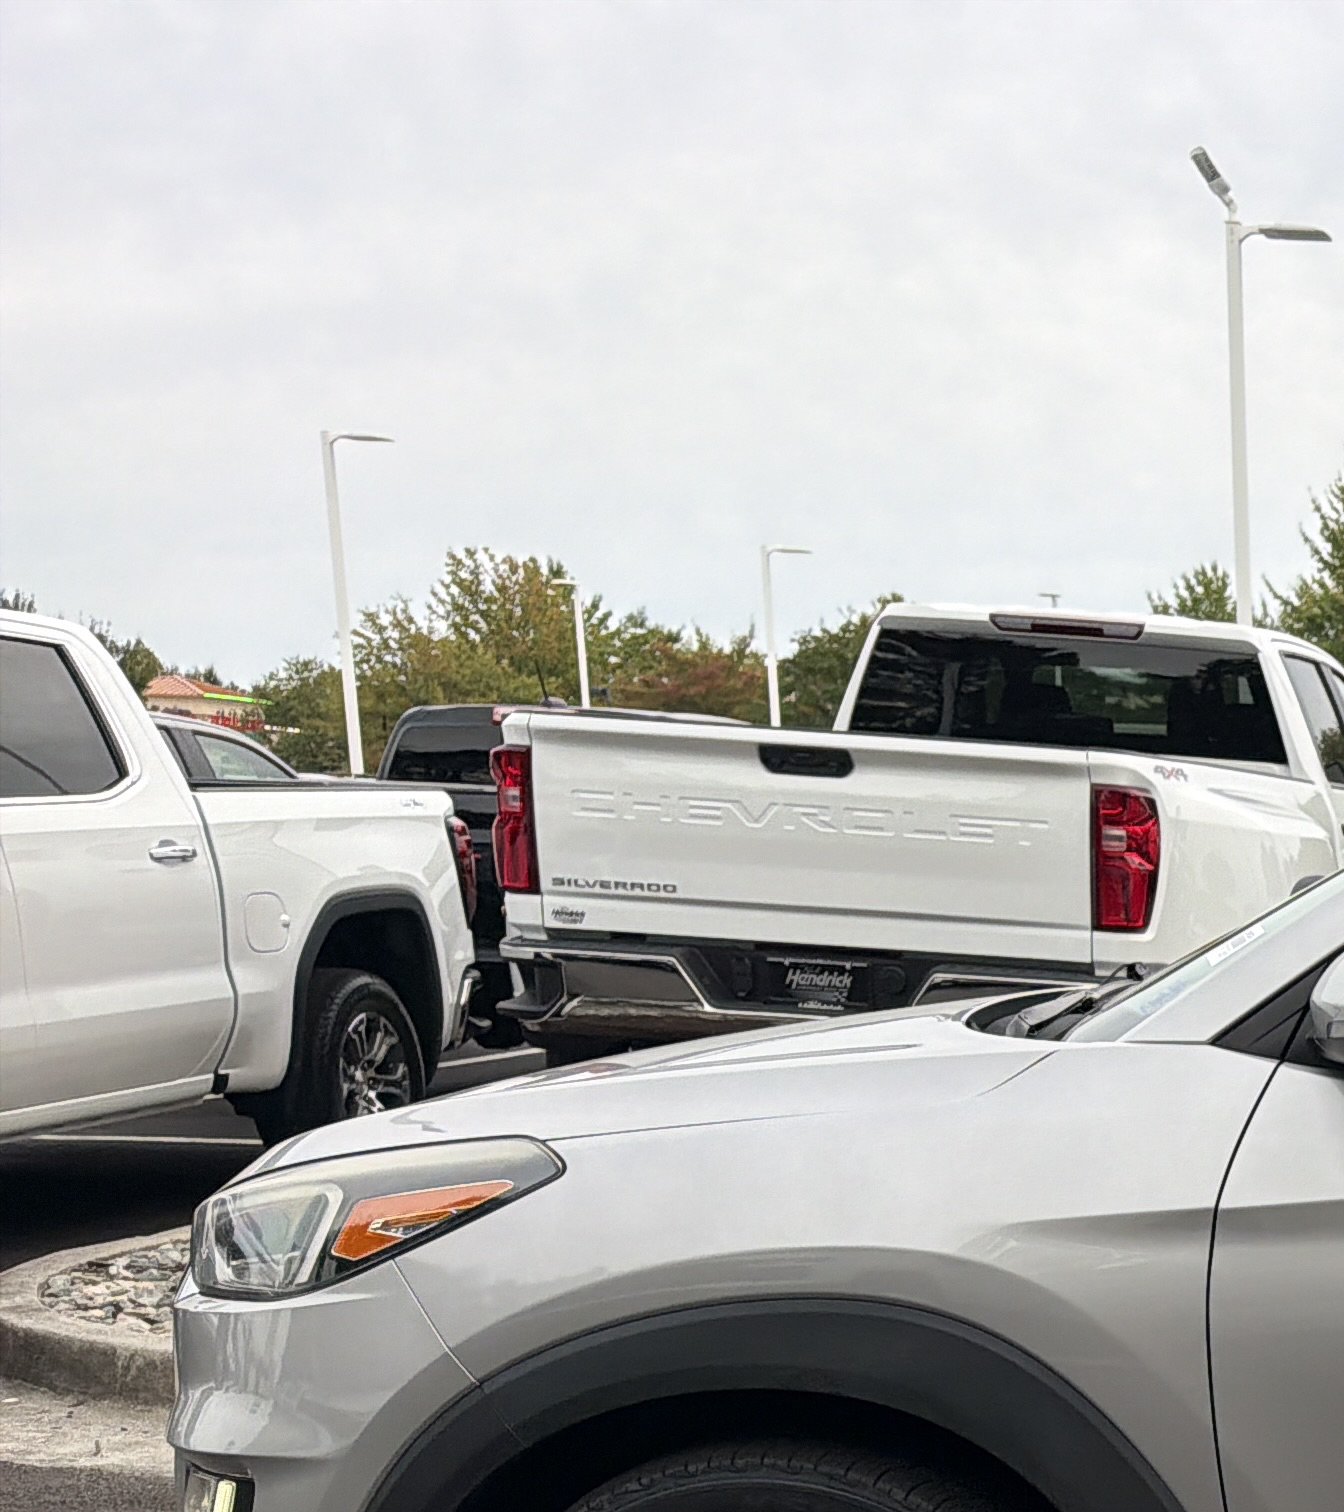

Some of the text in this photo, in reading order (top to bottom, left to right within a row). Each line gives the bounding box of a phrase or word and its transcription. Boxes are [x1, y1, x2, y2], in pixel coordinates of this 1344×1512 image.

[570, 788, 1050, 847] CHEVROLET
[551, 877, 677, 894] SILVERADO
[785, 968, 853, 990] Hendrick
